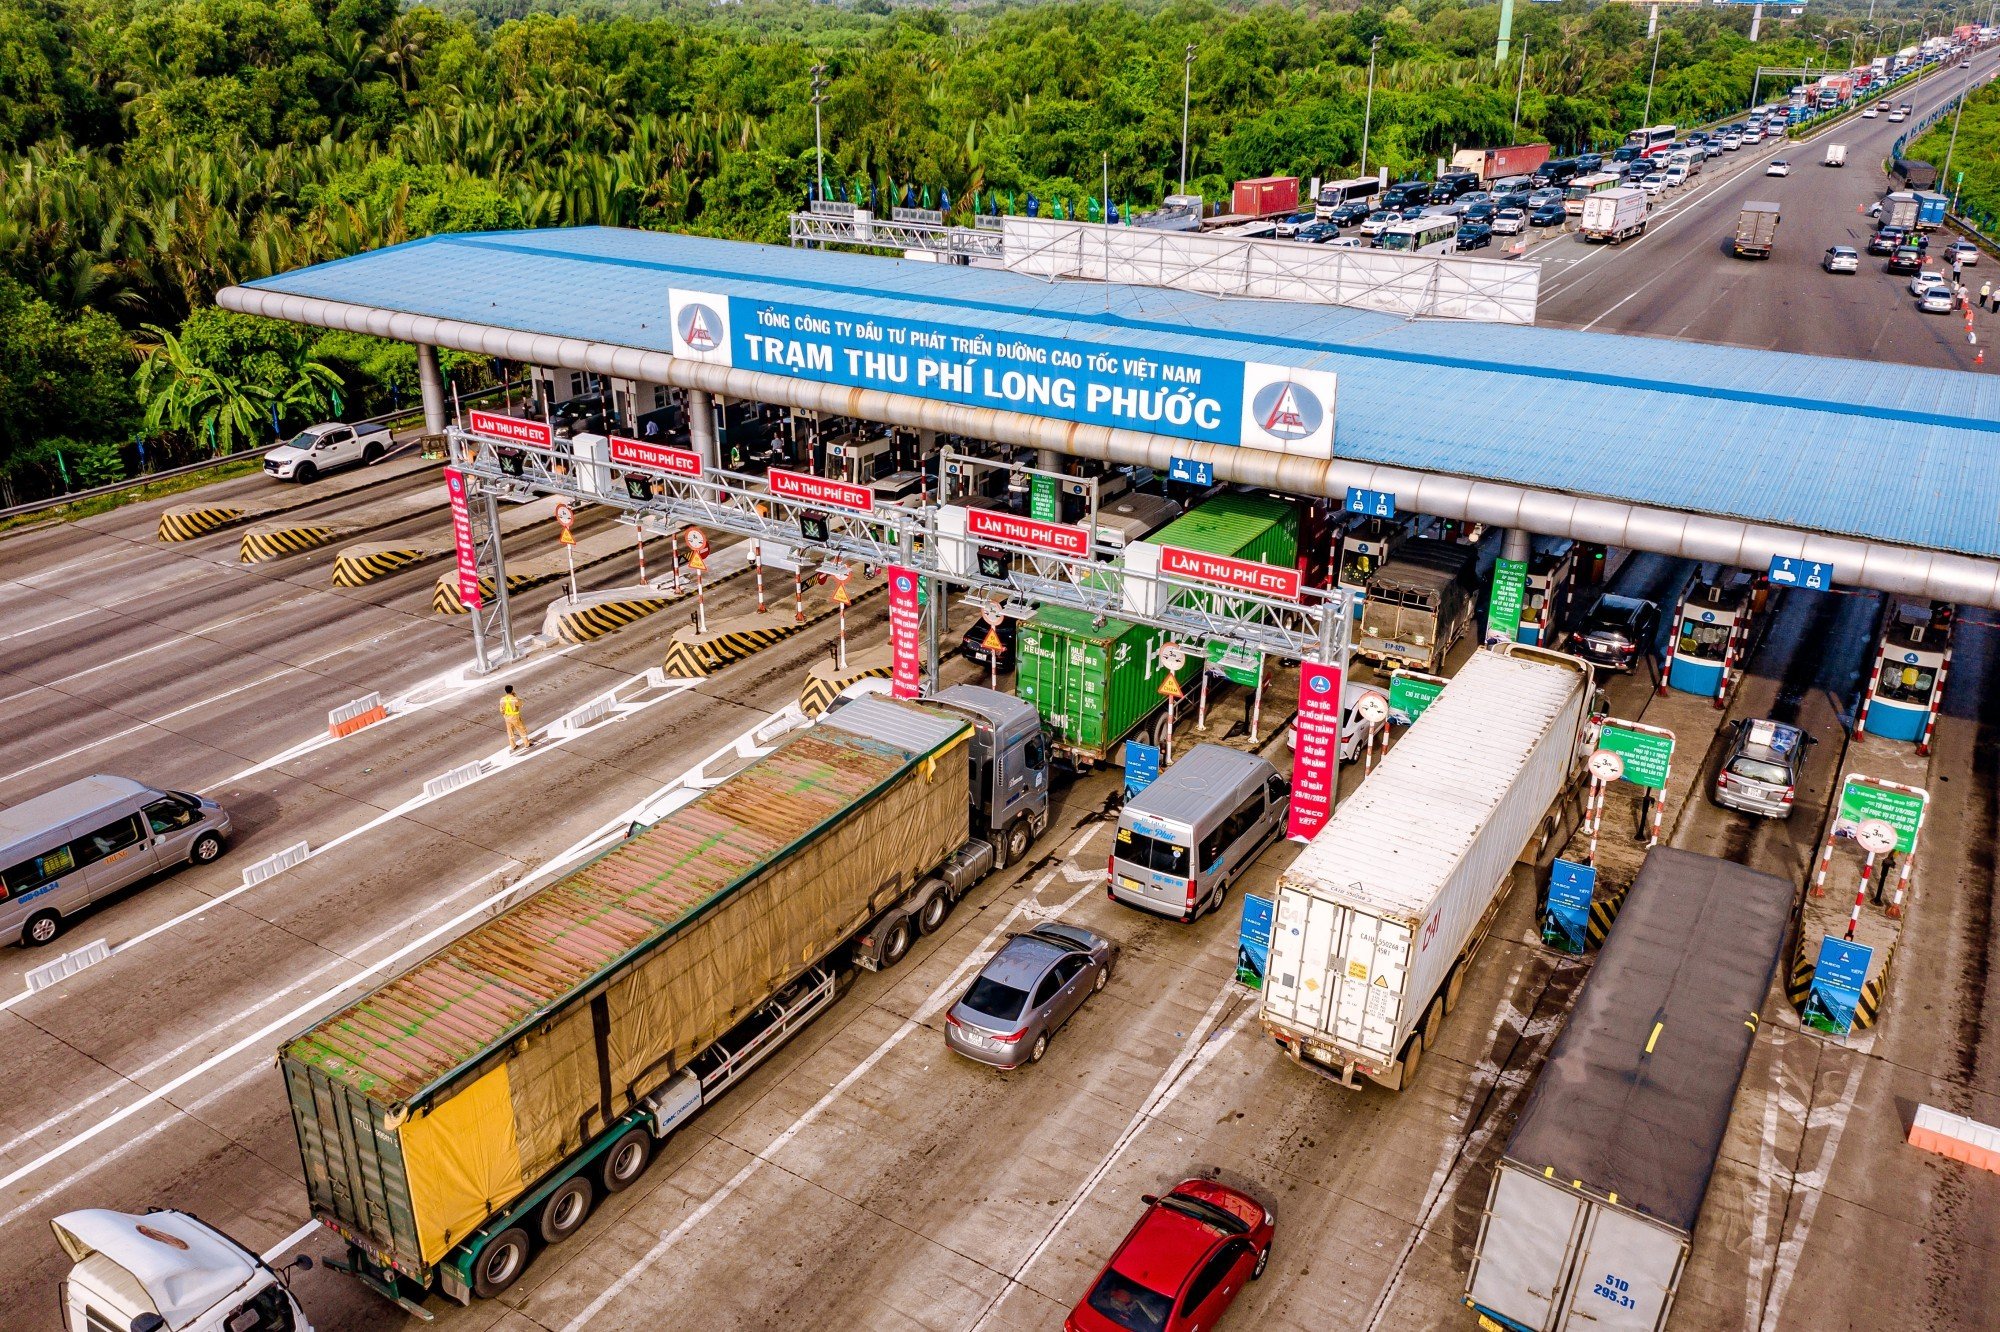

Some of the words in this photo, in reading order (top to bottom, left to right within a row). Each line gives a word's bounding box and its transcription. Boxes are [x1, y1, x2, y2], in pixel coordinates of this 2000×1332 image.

[757, 306, 790, 329] TỔNG
[795, 313, 831, 335] CÔNG
[835, 322, 851, 337] TY
[856, 320, 882, 341] ĐẦU
[887, 327, 906, 344] TƯ
[910, 327, 946, 350] PHÁT
[951, 334, 991, 357] TRIỂN
[996, 337, 1046, 364] ĐƯỜNG
[1051, 349, 1082, 369] CAO
[1087, 352, 1118, 374] TỐC
[1122, 358, 1158, 382] VIỆT
[1162, 364, 1201, 385] NAM
[744, 333, 833, 374] TRẠM
[843, 348, 907, 383] THU
[917, 358, 978, 394] PHÍ
[984, 368, 1076, 409] LONG
[1087, 386, 1221, 430] PHƯỚC
[477, 418, 495, 432] LÀN
[496, 423, 512, 436] THU
[513, 424, 528, 438] PHÍ
[529, 429, 545, 441] ETC
[618, 444, 636, 459] LÀN
[638, 450, 657, 463] THU
[658, 451, 675, 466] PHÍ
[676, 457, 694, 470] ETC
[777, 478, 798, 493] LÀN
[800, 483, 821, 497] THU
[823, 486, 842, 500] PHÍ
[844, 491, 864, 505] ETC
[977, 516, 1002, 533] LÀN
[1004, 523, 1029, 538] THU
[1031, 525, 1052, 542] PHÍ
[1054, 533, 1078, 548] ETC
[1171, 555, 1199, 572] LÀN
[1203, 562, 1230, 578] THU
[1233, 569, 1257, 584] PHÍ
[1259, 574, 1286, 590] ETC
[1294, 806, 1323, 818] TASCO
[104, 850, 129, 865] TRUNG
[1360, 933, 1375, 943] CAIU
[1379, 939, 1399, 951] 550268
[662, 1112, 677, 1127] CIMC
[1605, 1274, 1630, 1293] 51D
[1593, 1284, 1636, 1310] 295.31
